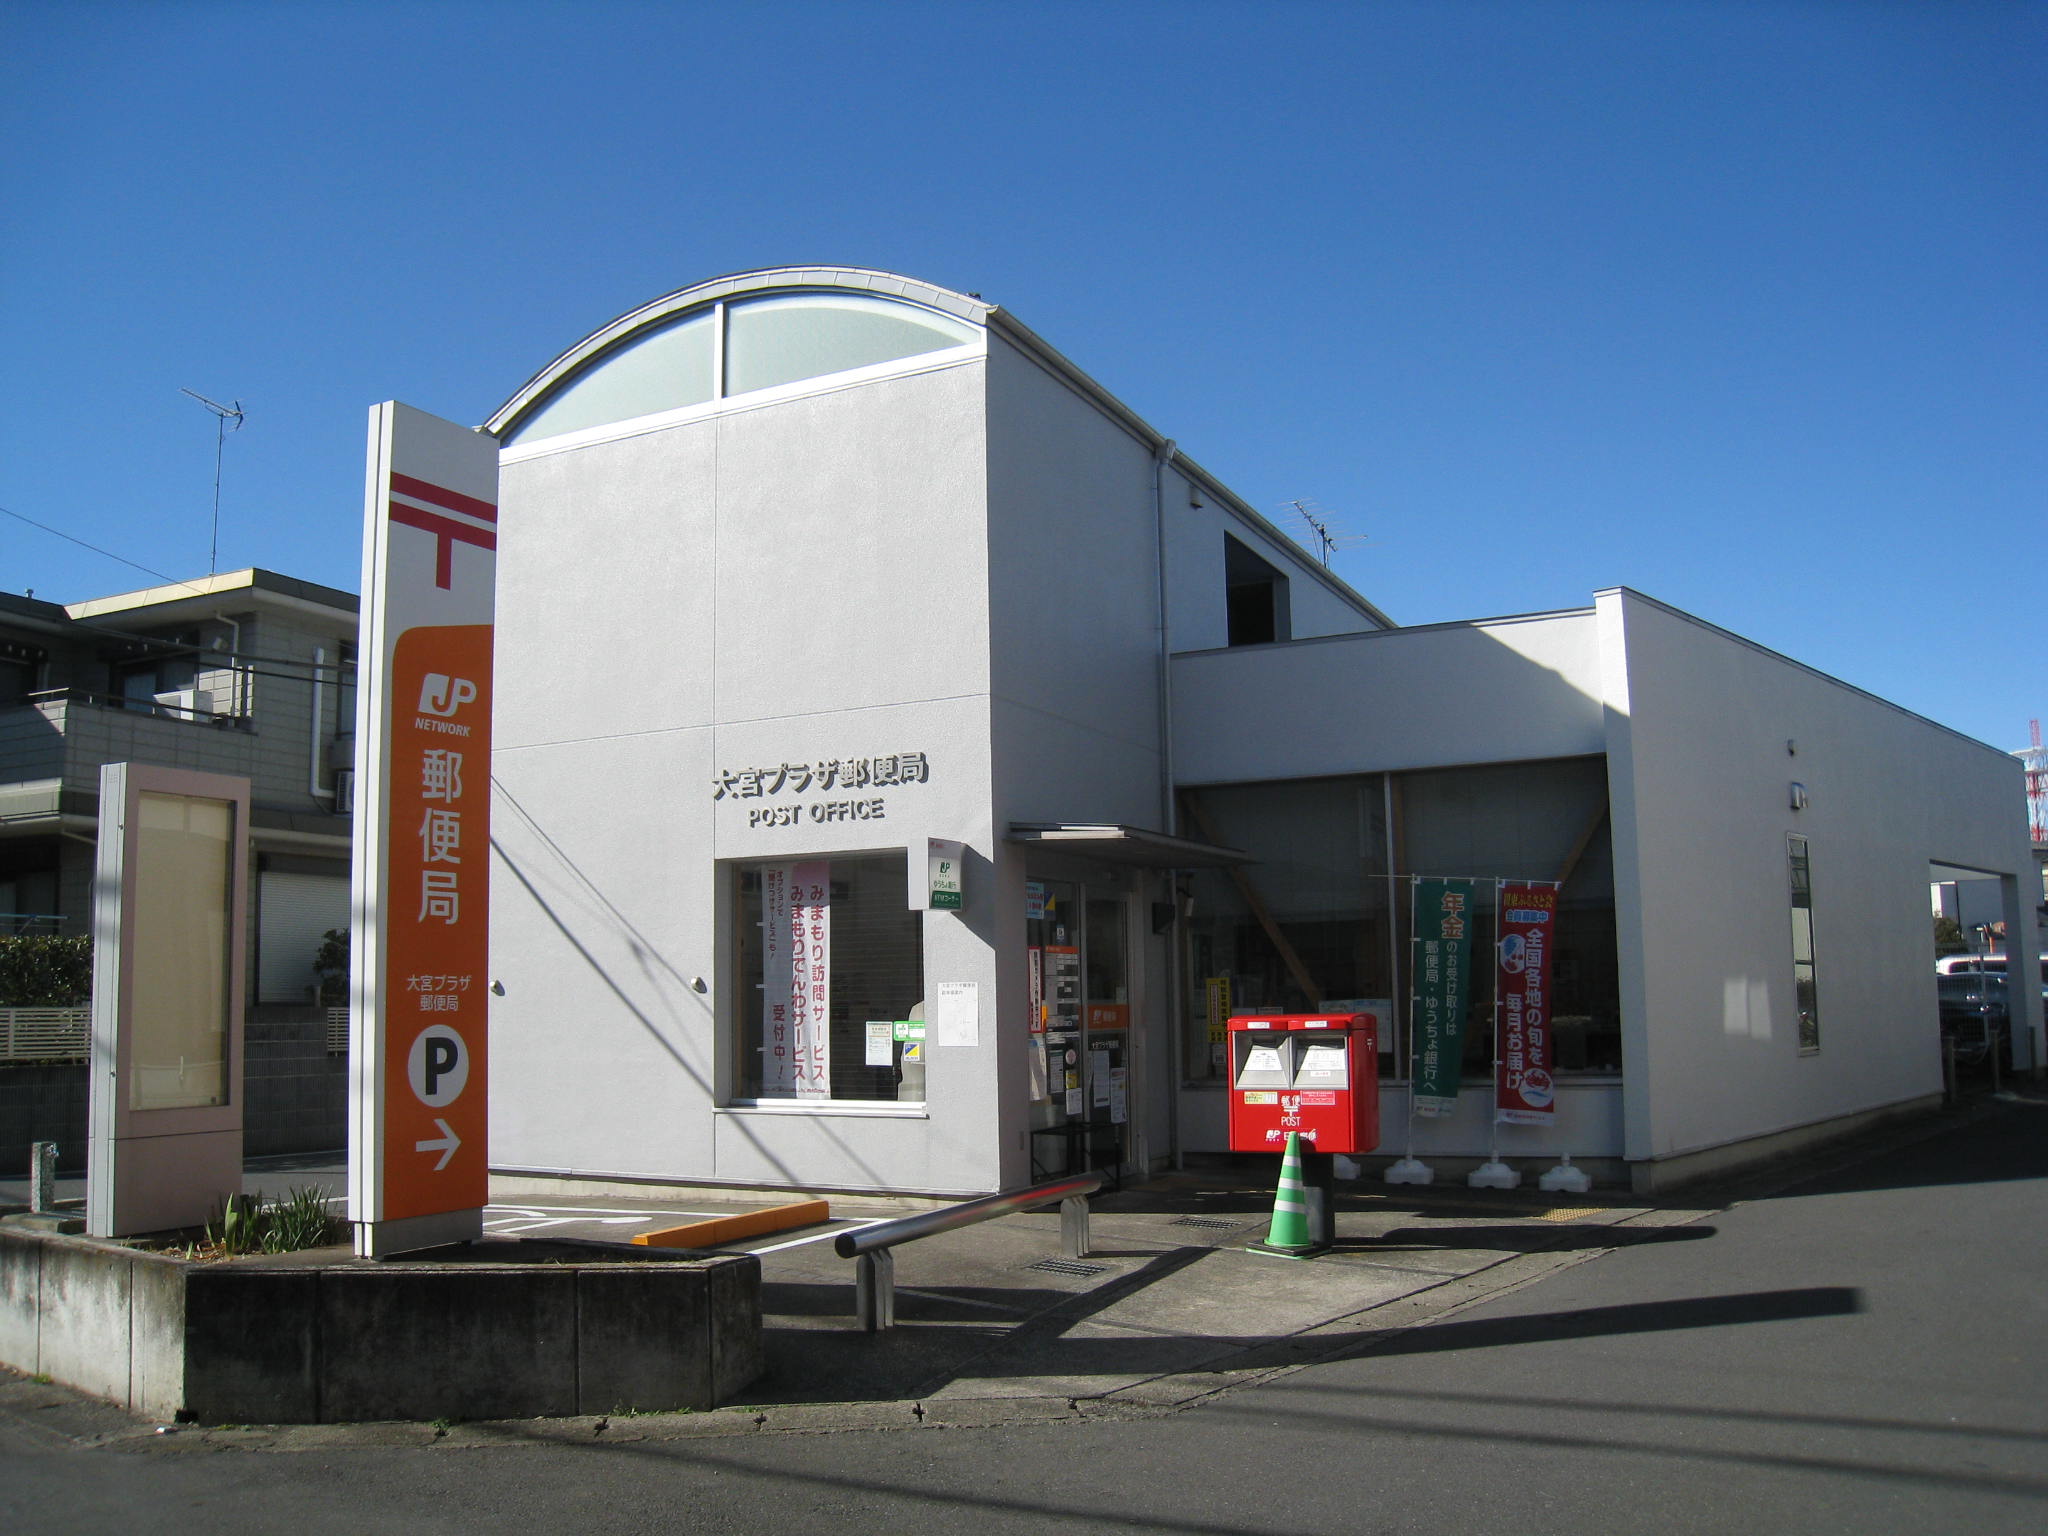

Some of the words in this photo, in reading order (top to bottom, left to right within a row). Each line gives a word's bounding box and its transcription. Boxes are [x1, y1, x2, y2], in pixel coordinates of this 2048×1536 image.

[415, 717, 471, 737] NETWORK
[712, 752, 929, 801] 大宮プラザ郵便局
[418, 749, 463, 925] 郵便局
[749, 805, 802, 829] POST
[808, 798, 886, 824] OFFICE
[407, 974, 472, 992] 大宮プラザ
[420, 994, 459, 1011] 郵便局
[791, 885, 807, 1081] みまもりでんわサービス
[810, 884, 826, 1081] みまもり訪問サービス
[1524, 928, 1544, 1066] 全国各地の旬を
[1424, 940, 1439, 1092] 郵便局・ゆうちょ銀行へ
[1506, 992, 1524, 1090] 毎月お届け
[425, 1037, 458, 1095] P
[1281, 1095, 1301, 1107] 郵便
[1281, 1117, 1301, 1127] POST
